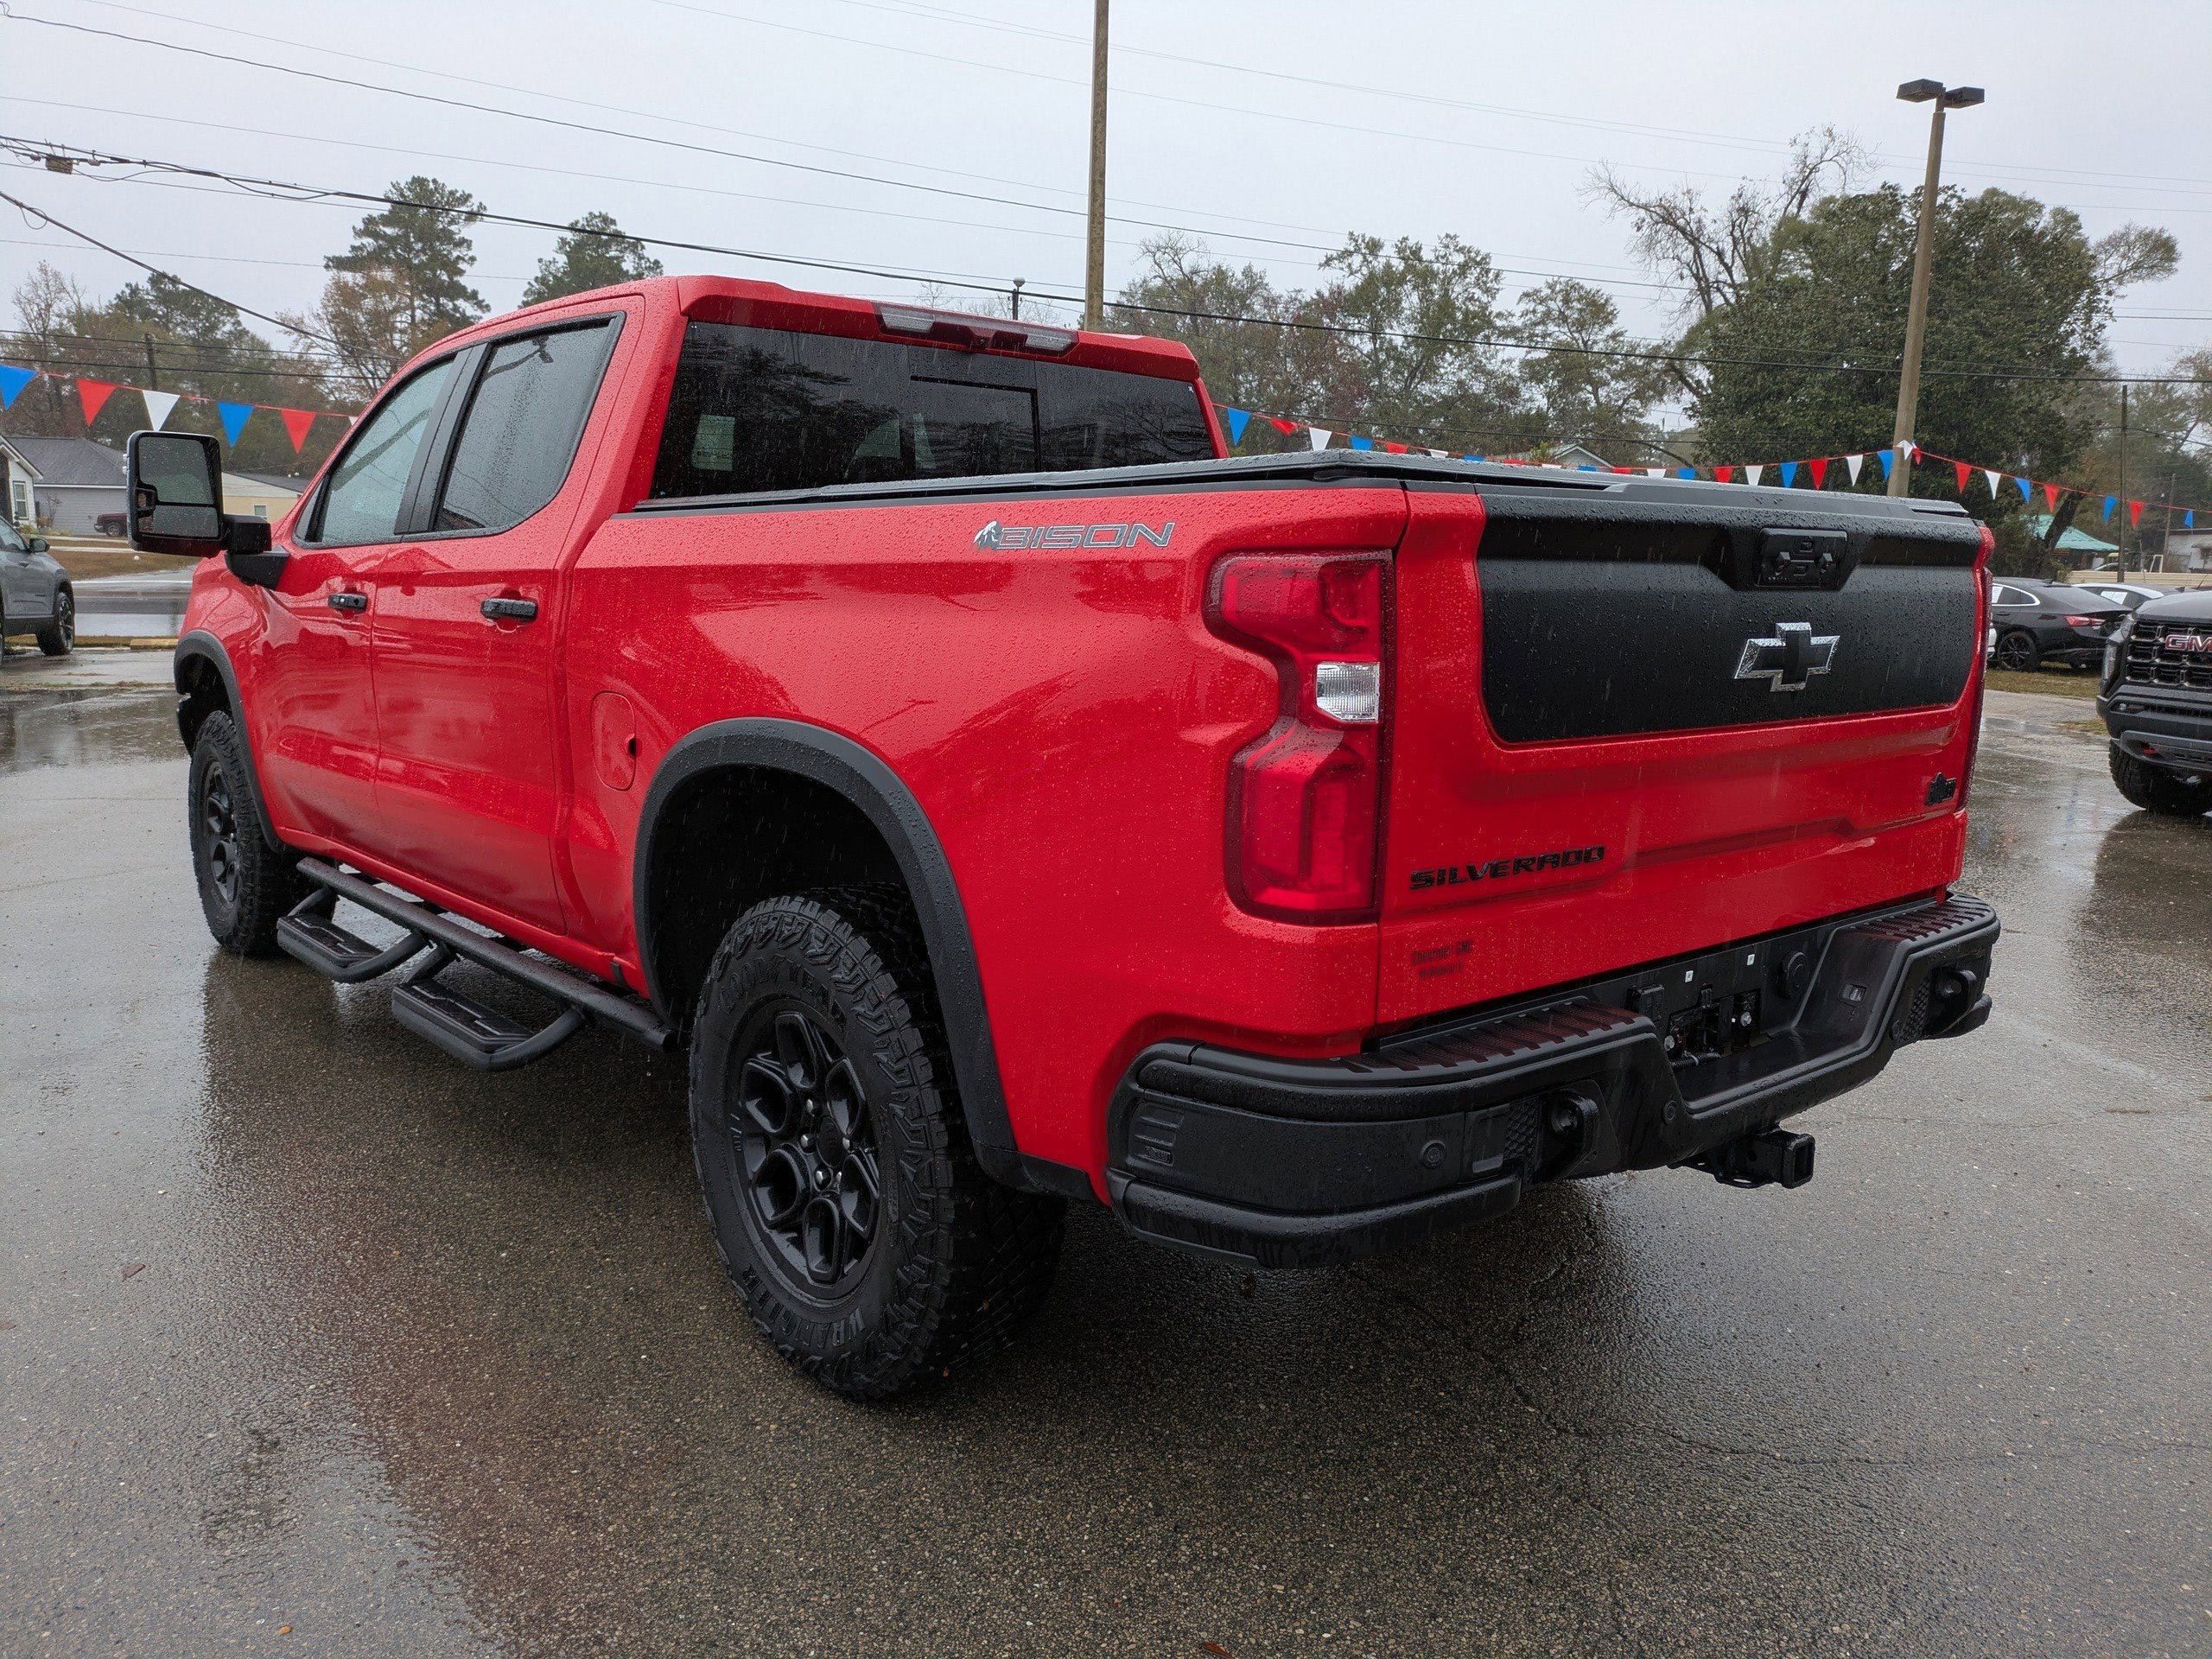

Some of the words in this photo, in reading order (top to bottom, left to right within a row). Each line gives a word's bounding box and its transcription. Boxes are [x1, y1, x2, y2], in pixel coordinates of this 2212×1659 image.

[995, 522, 1176, 550] BISON
[2164, 633, 2212, 653] GM
[1409, 844, 1606, 892] SILVERADO
[741, 1263, 866, 1350] WRANGLER
